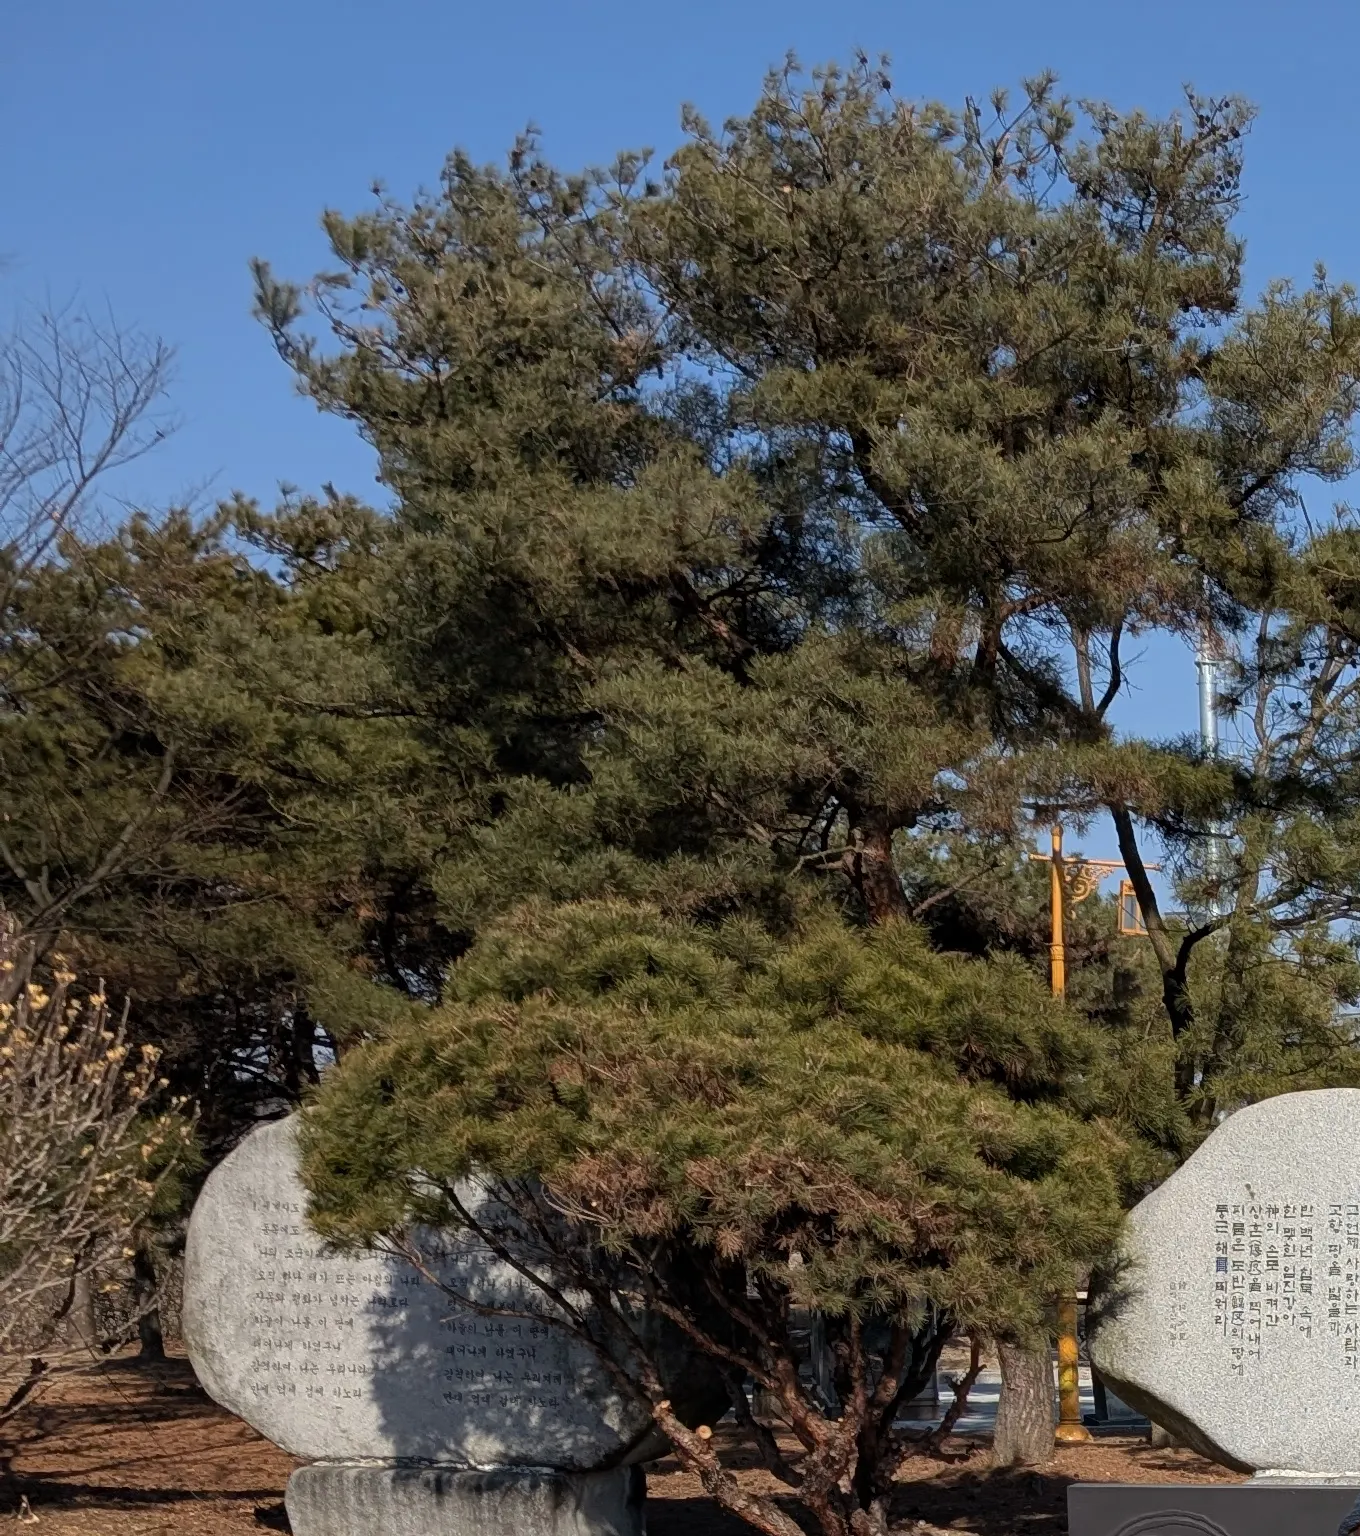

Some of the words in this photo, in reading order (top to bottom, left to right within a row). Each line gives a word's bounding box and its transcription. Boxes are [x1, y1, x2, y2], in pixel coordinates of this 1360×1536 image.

[1328, 1204, 1343, 1234] 고향
[1283, 1265, 1297, 1327] 임진강아
[1345, 1257, 1360, 1315] 사랑하는
[1344, 1322, 1358, 1370] 사람과
